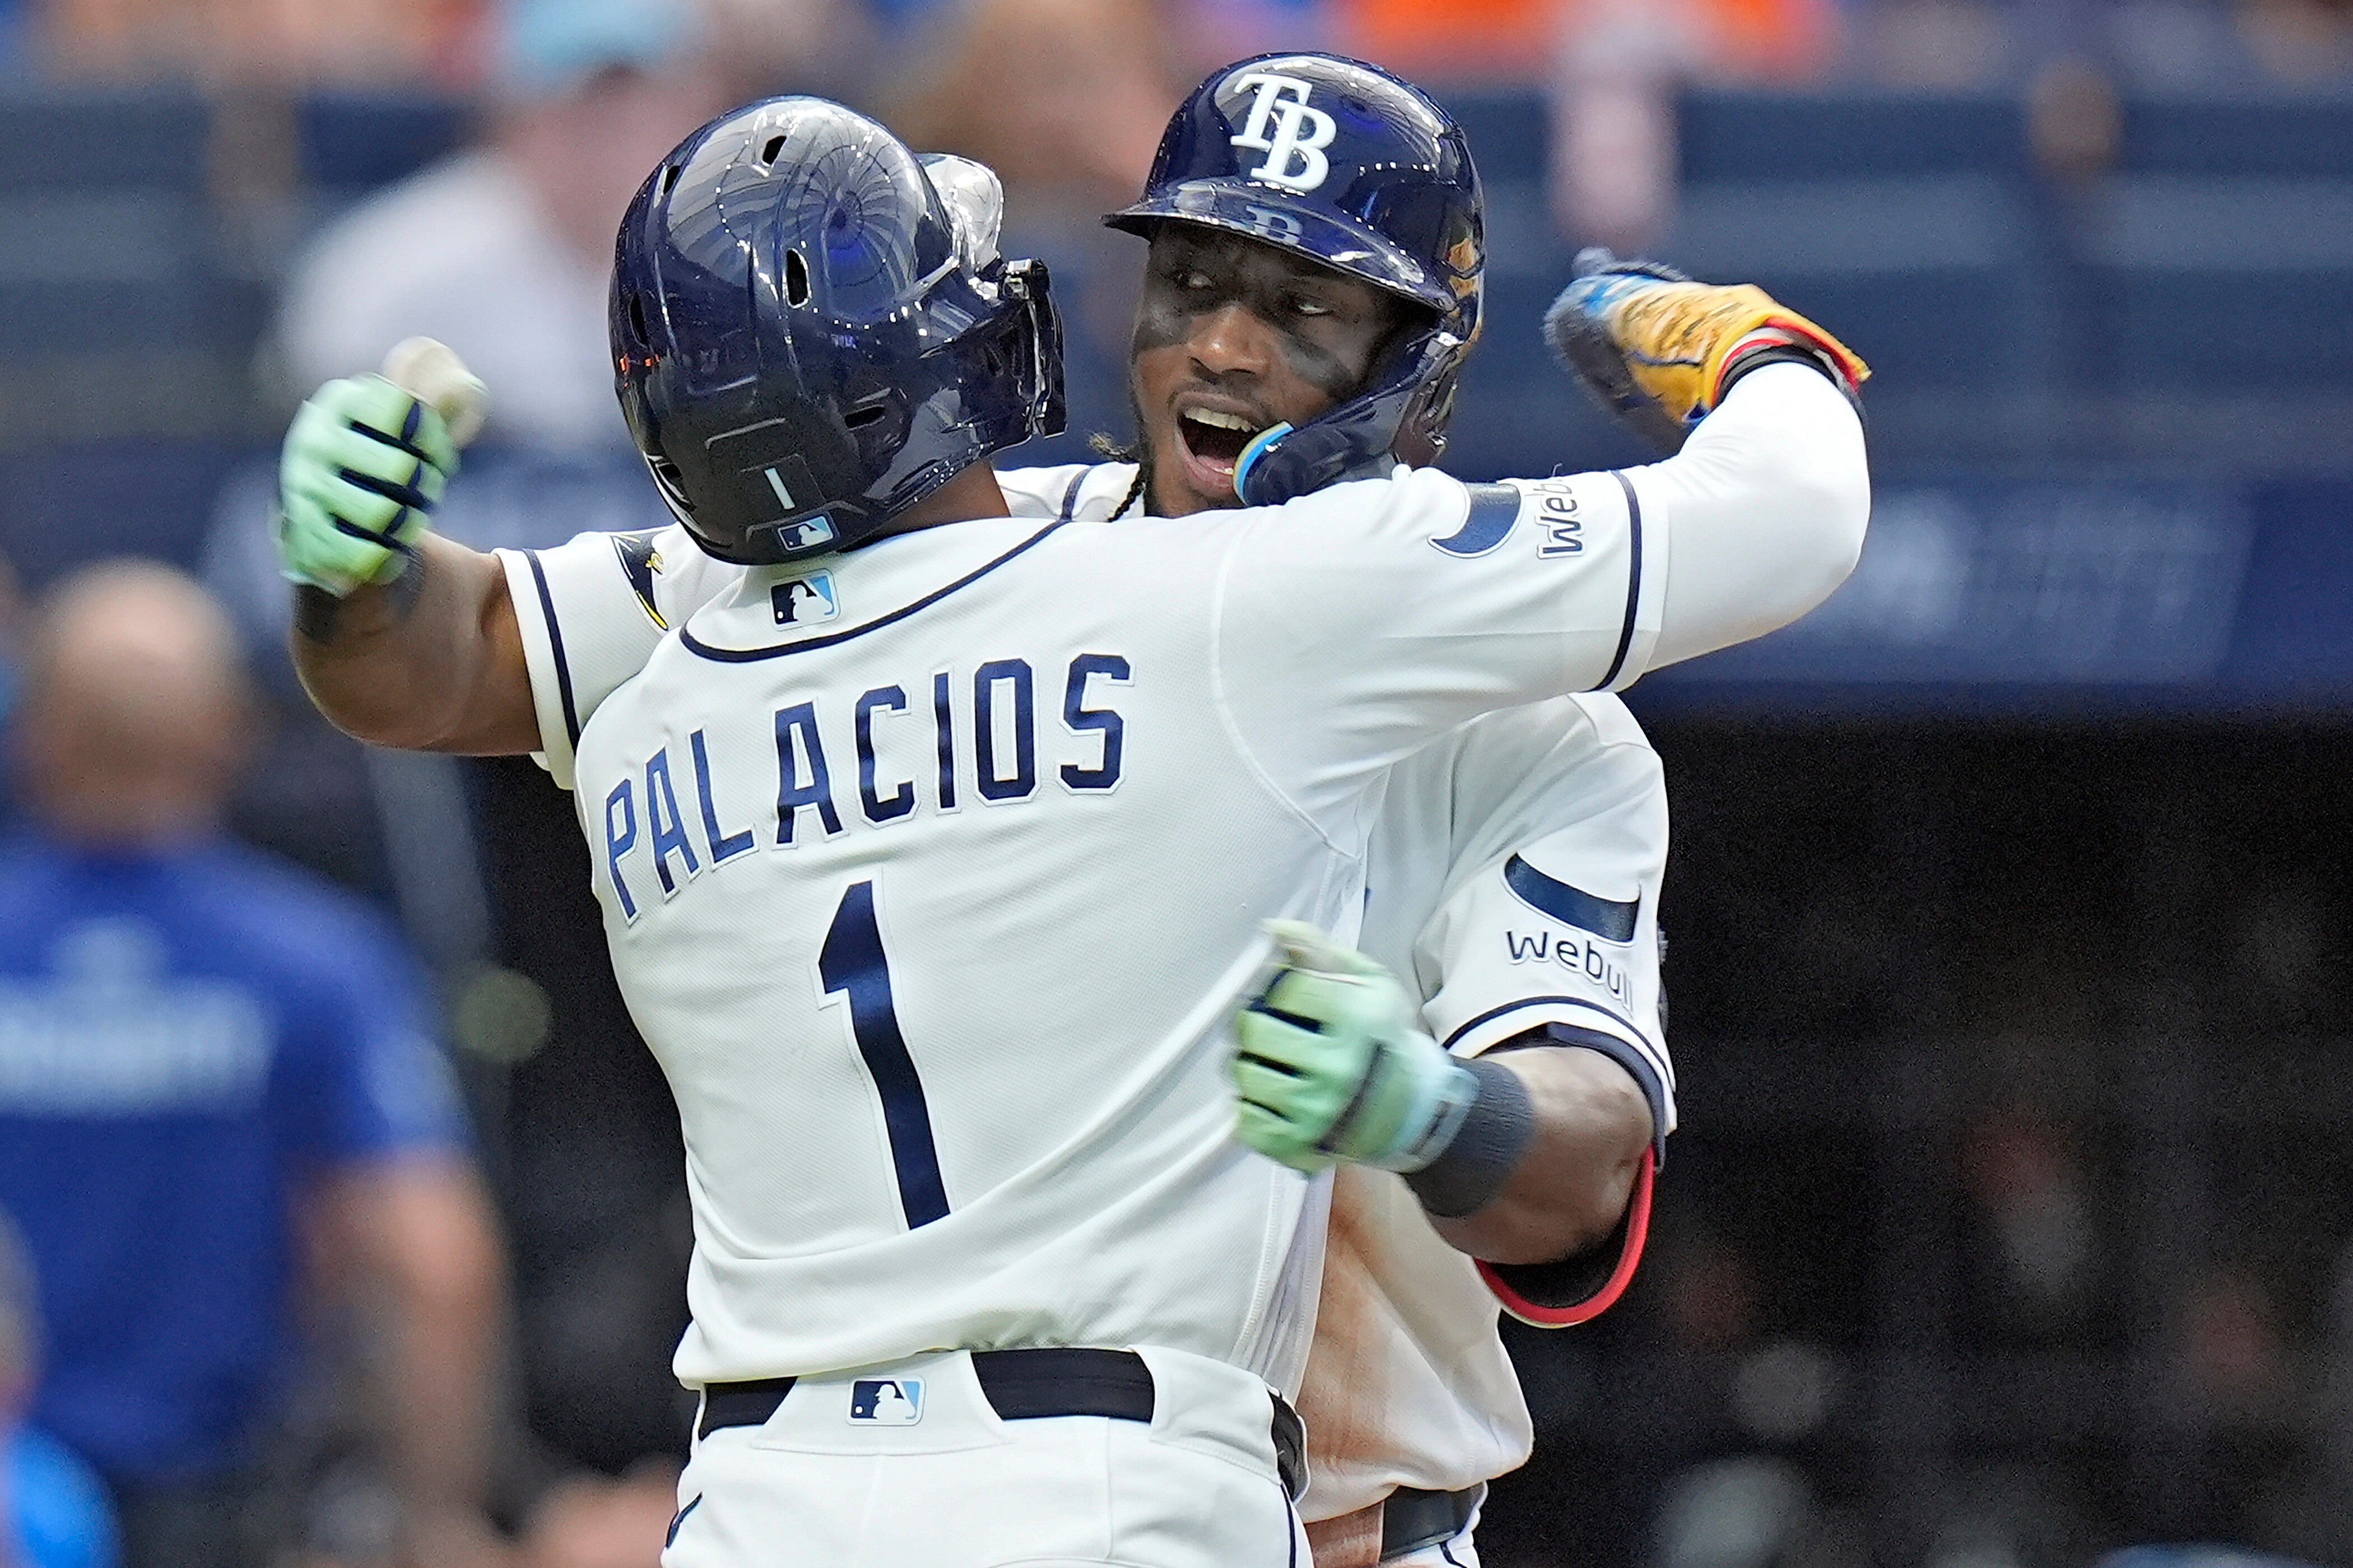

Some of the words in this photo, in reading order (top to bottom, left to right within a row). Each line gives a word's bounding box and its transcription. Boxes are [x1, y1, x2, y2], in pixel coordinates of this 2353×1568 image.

[1230, 73, 1337, 190] TB
[764, 467, 796, 510] 1
[605, 653, 1132, 922] PALACIOS
[817, 878, 952, 1231] 1
